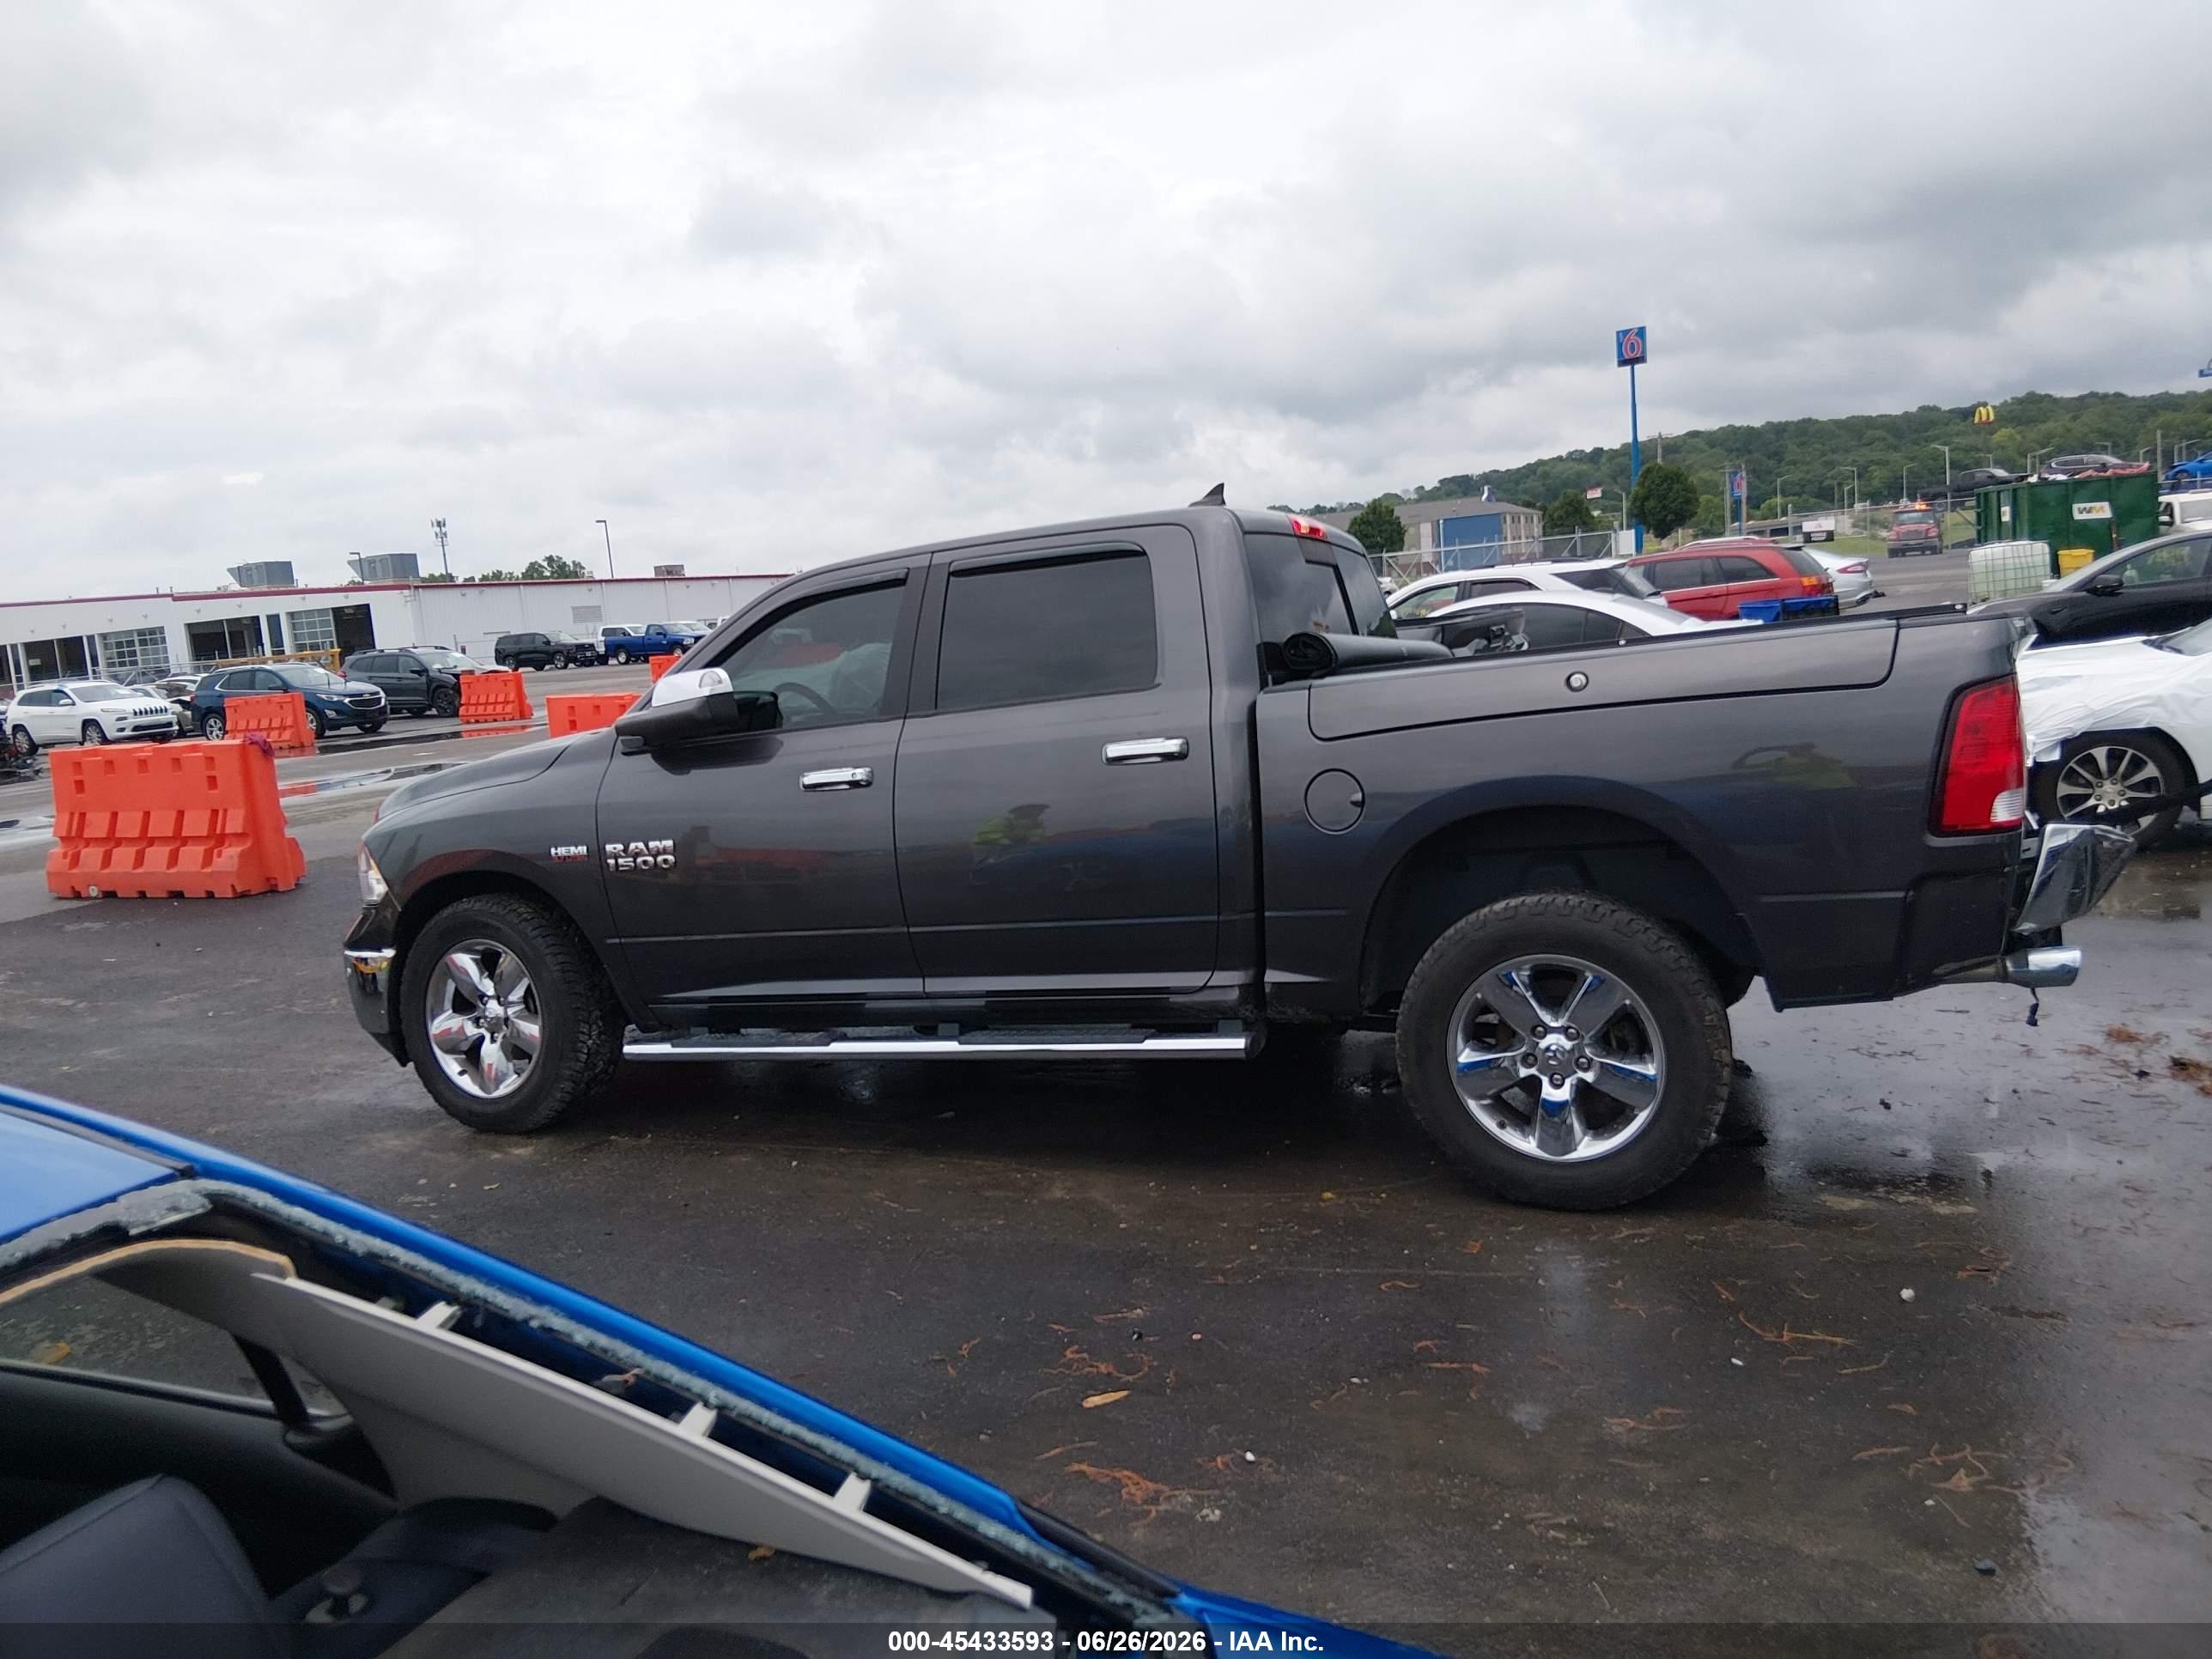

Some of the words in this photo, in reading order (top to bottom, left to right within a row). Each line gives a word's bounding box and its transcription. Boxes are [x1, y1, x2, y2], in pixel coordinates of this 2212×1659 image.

[1622, 328, 1642, 358] 6
[550, 845, 587, 857] HEMI
[605, 839, 674, 857] RAM
[606, 854, 676, 872] 1500
